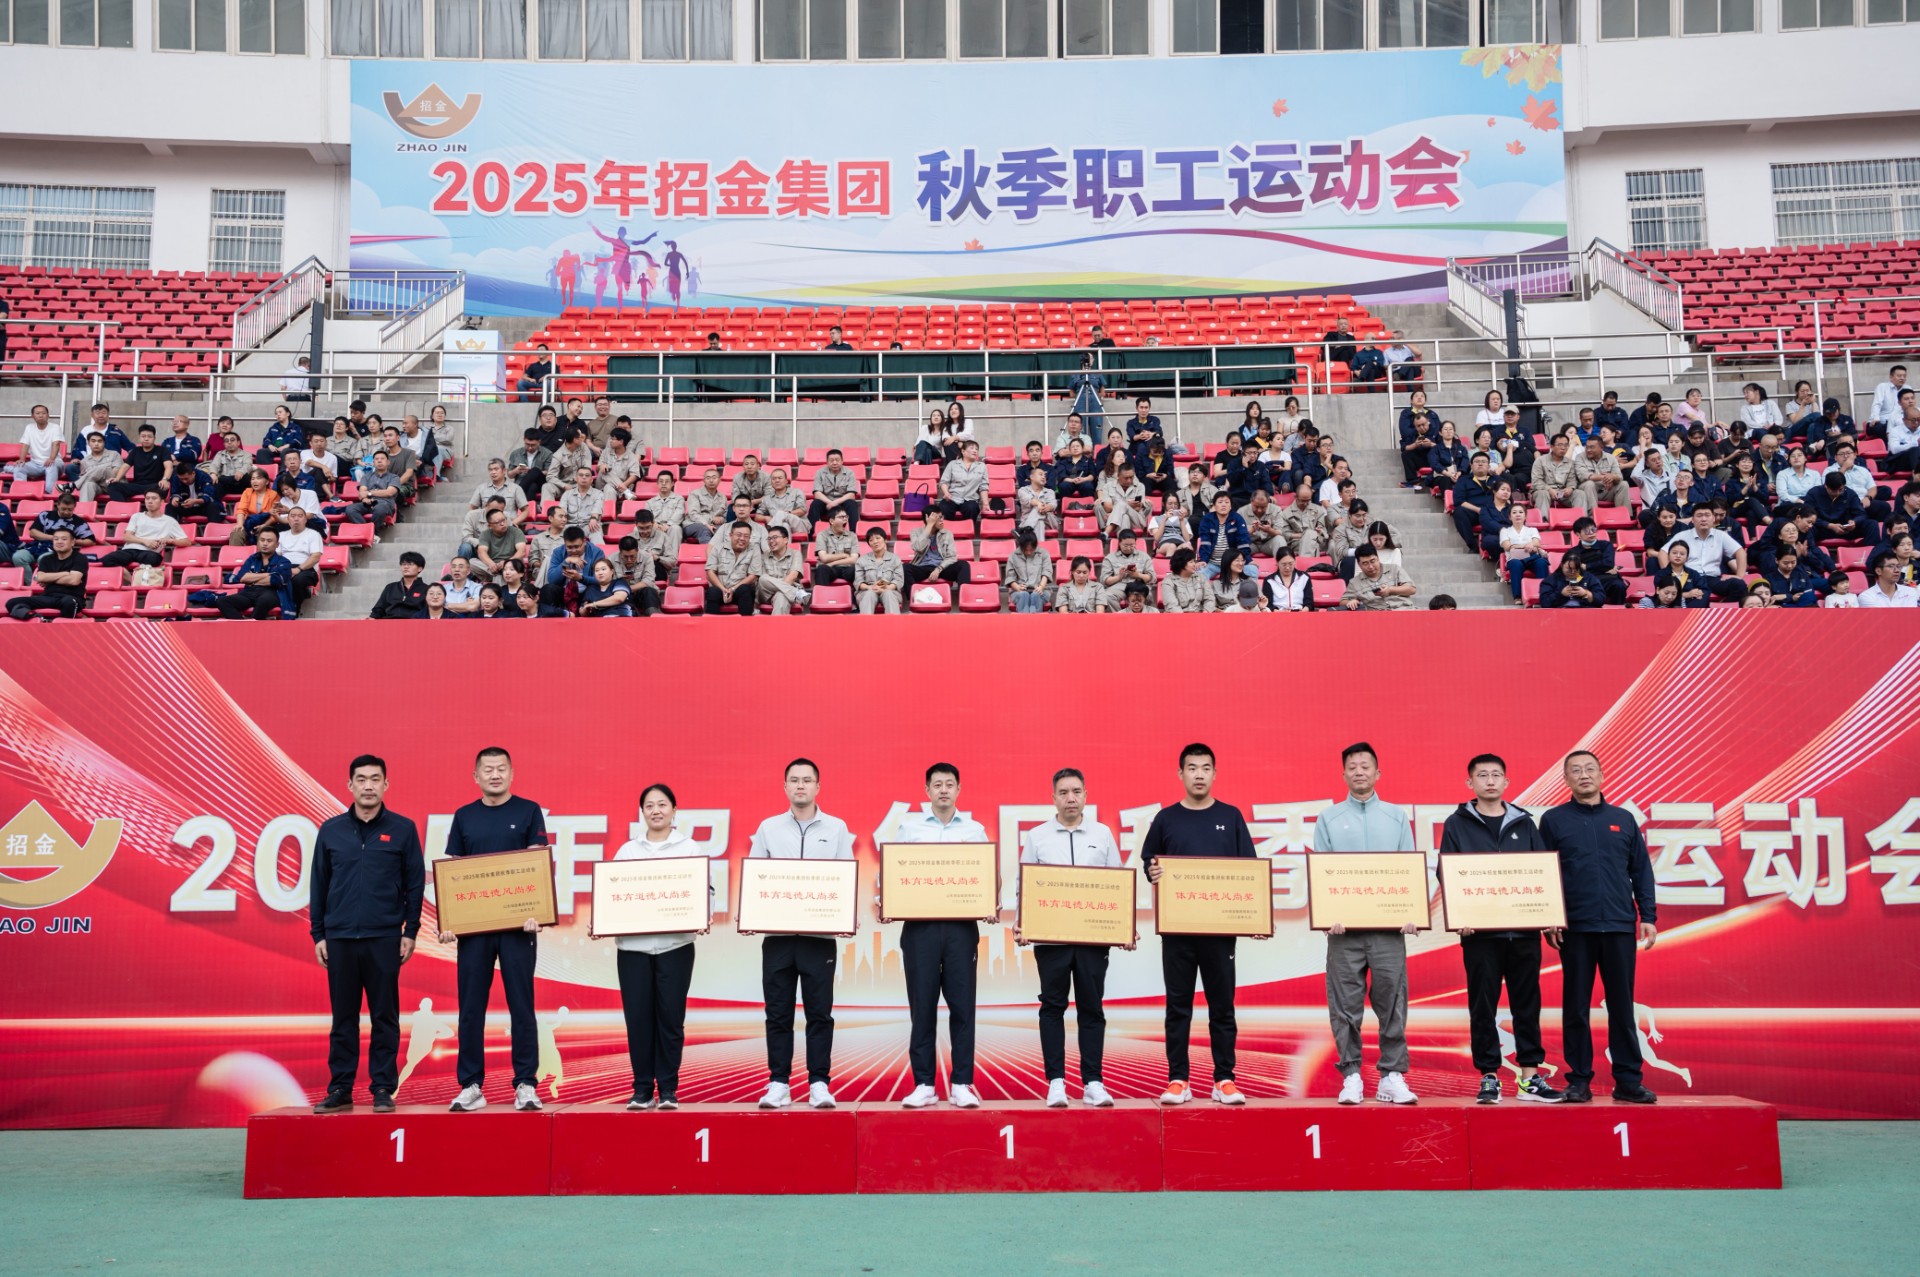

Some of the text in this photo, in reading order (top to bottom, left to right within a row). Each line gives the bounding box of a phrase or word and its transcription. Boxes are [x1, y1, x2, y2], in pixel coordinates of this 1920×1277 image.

[420, 100, 447, 112] 招金
[397, 143, 467, 152] ZHAO JIN
[432, 136, 1463, 222] 2025年招金集团 秋季职工运动会
[6, 833, 56, 856] 招金
[44, 918, 91, 933] JIN
[390, 1128, 405, 1162] 1
[694, 1128, 709, 1162] 1
[999, 1125, 1014, 1159] 1
[1305, 1124, 1320, 1159] 1
[1613, 1122, 1629, 1157] 1
